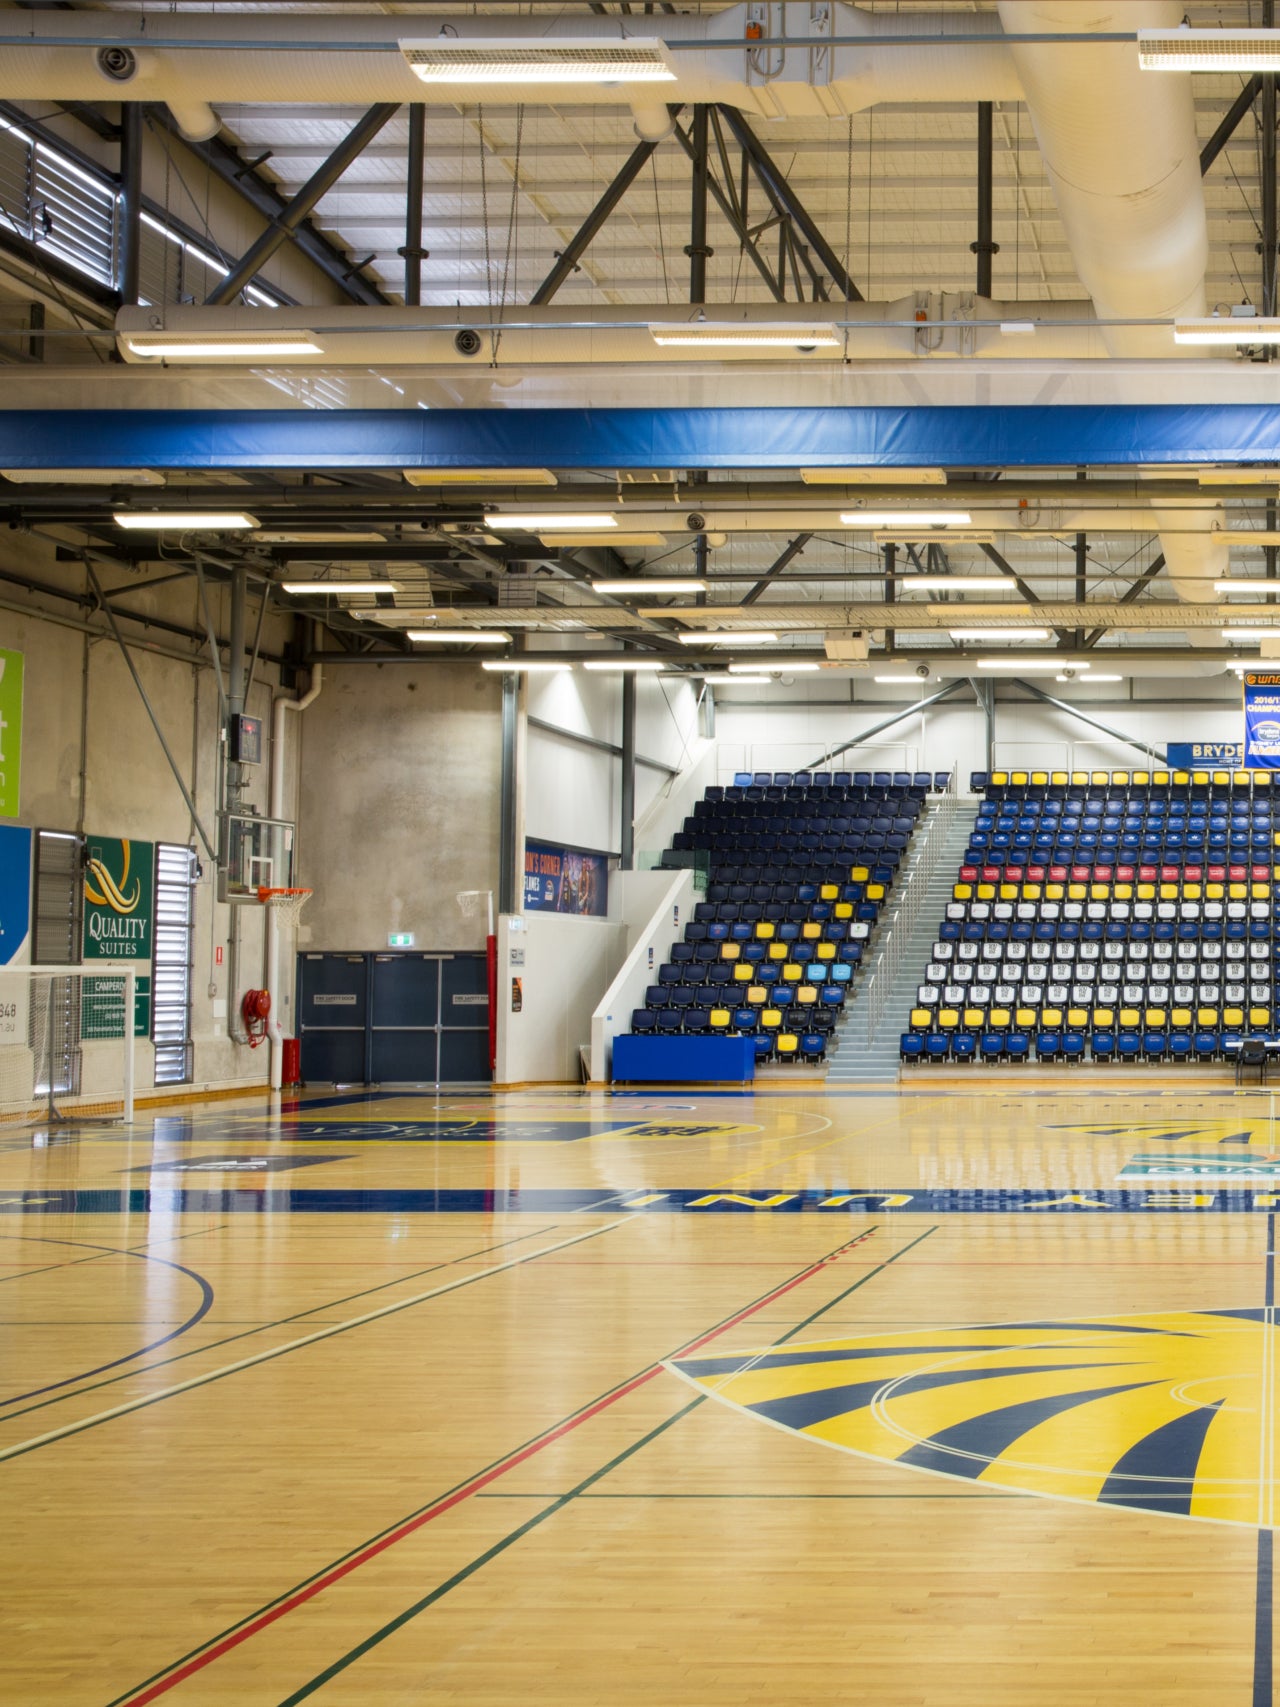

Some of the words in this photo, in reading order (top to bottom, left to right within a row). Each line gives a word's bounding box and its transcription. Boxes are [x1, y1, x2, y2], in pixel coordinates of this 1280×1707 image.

[1192, 745, 1243, 757] BRYDE
[540, 853, 561, 877] CORNER
[89, 912, 147, 941] QUALITY
[100, 942, 137, 955] SUITES
[95, 981, 139, 991] CAMPERDN
[619, 1193, 912, 1207] UNI
